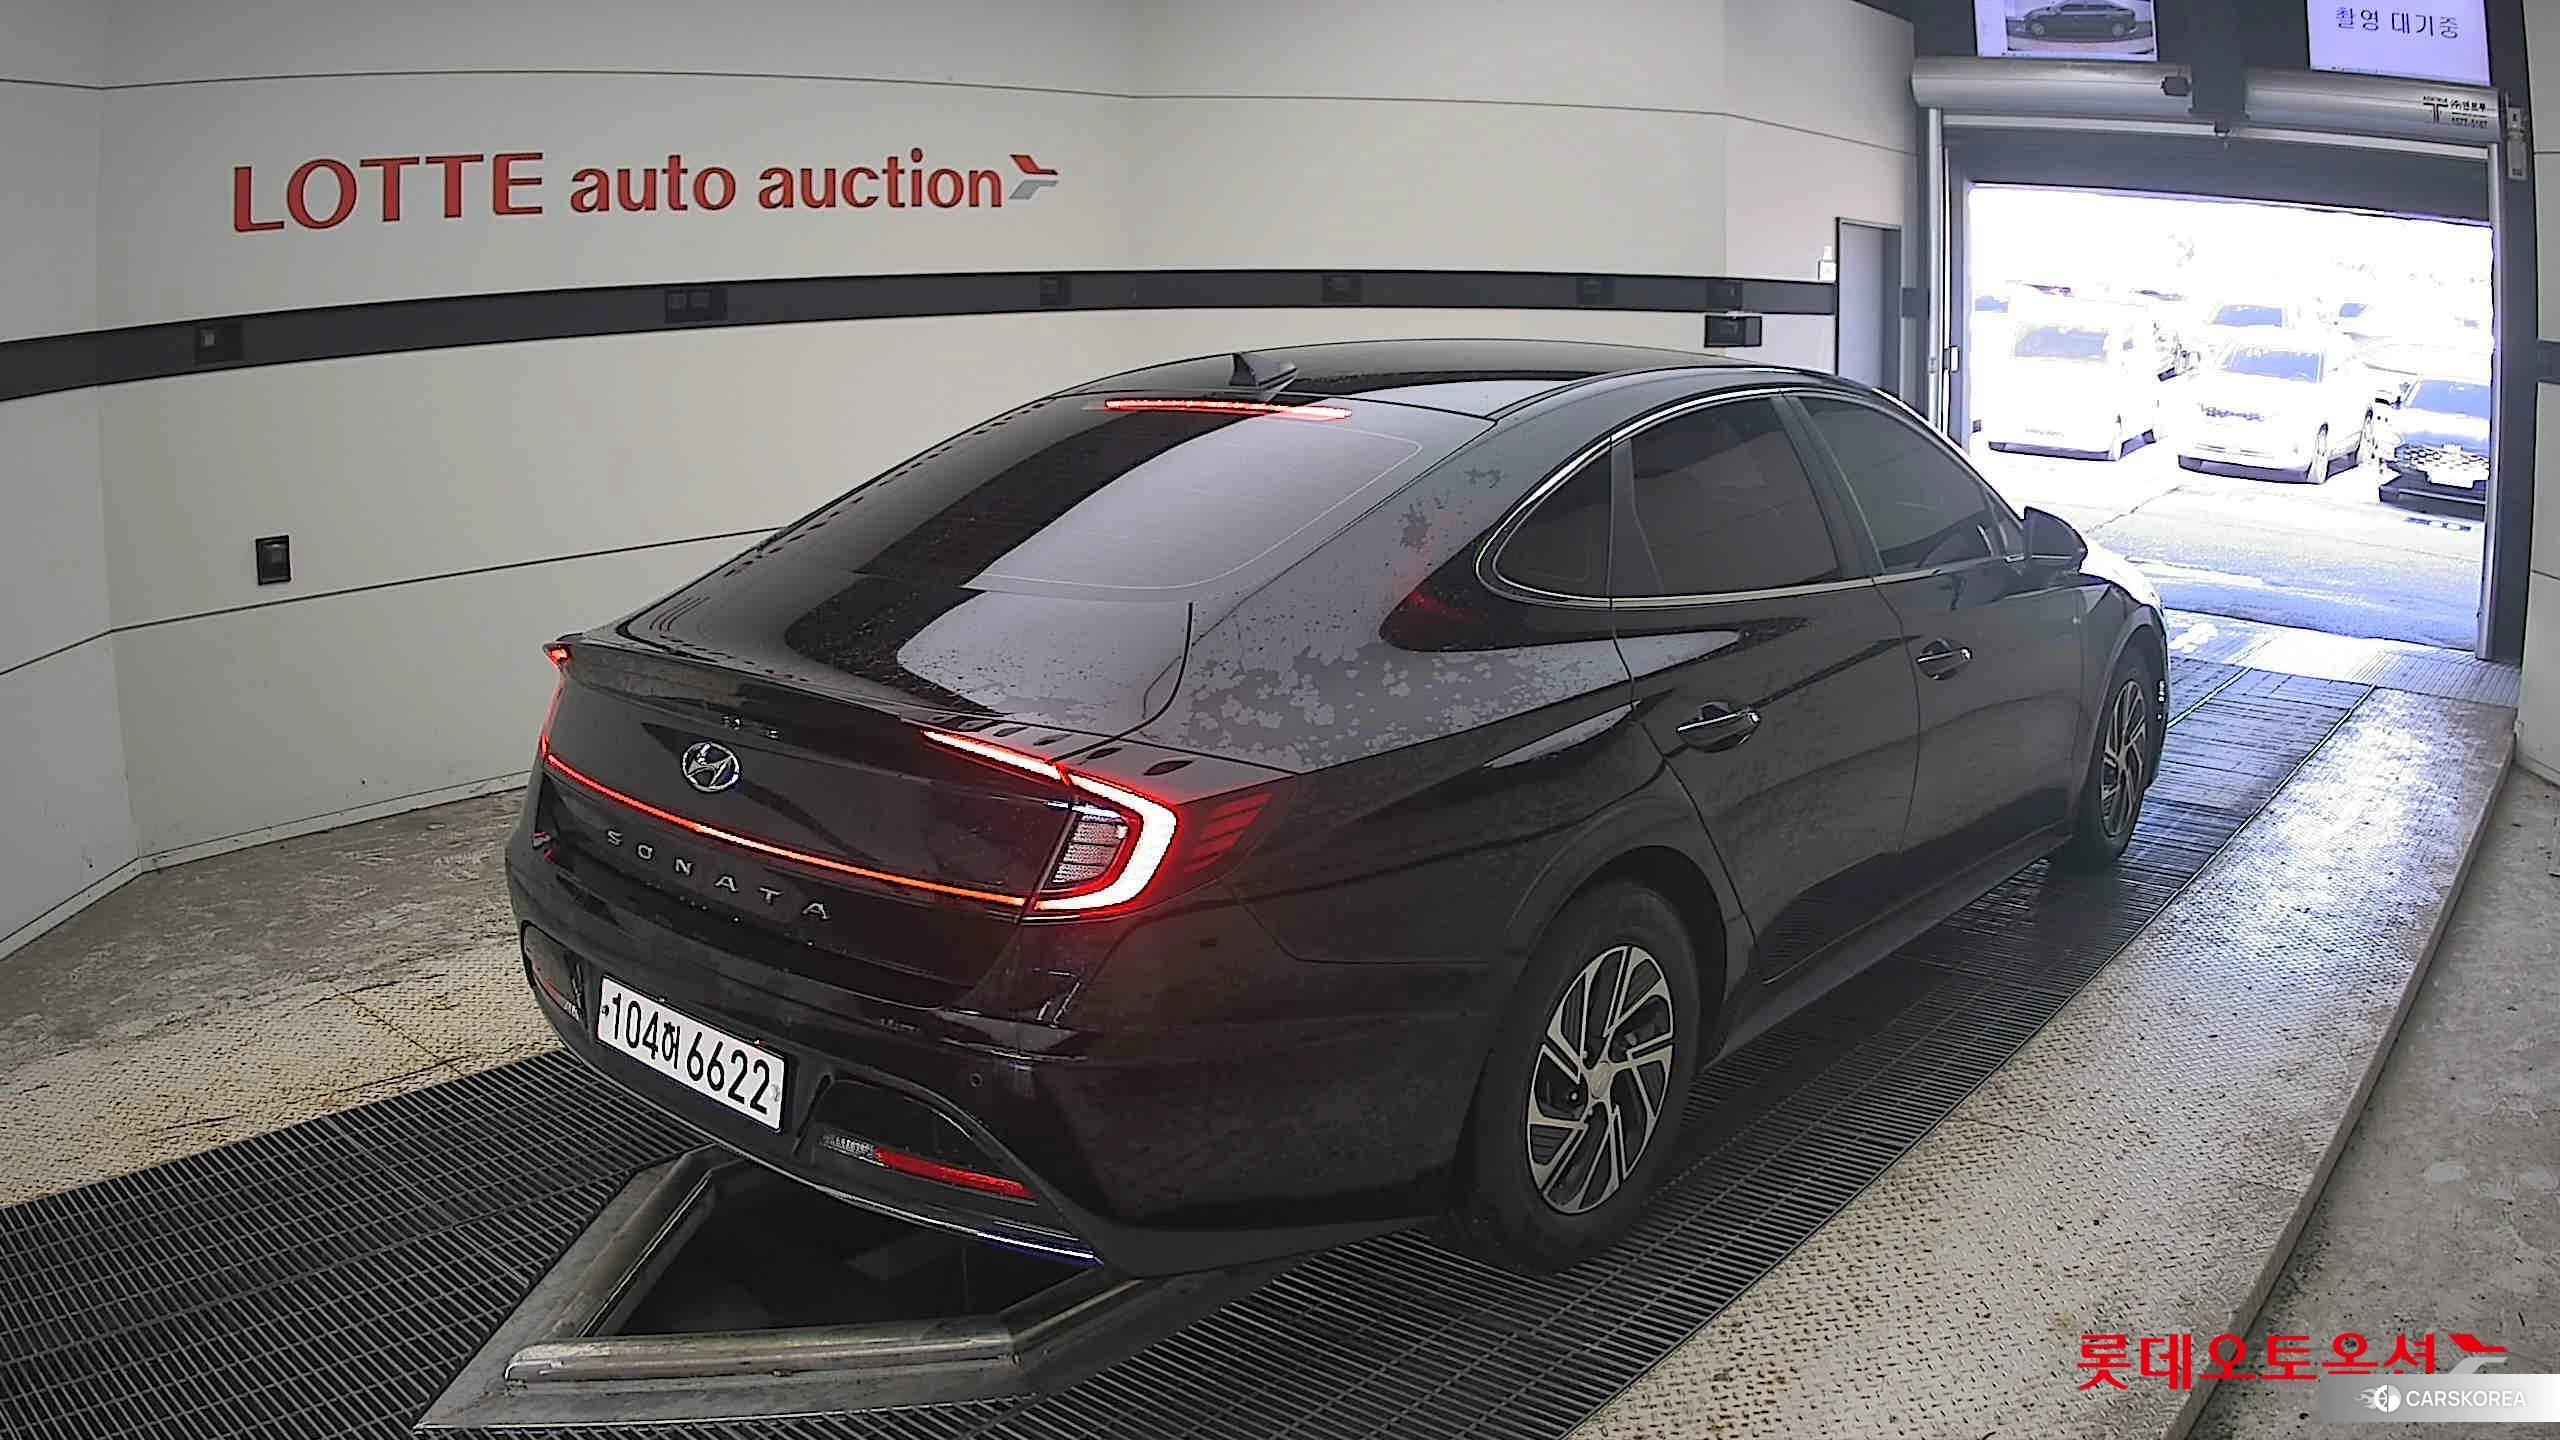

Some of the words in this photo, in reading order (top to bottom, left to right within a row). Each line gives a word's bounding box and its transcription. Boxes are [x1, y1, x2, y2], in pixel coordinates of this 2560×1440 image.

[2336, 7, 2379, 31] 촬영
[2391, 12, 2459, 39] 대기중
[234, 152, 543, 232] LOTTE
[570, 154, 736, 212] auto
[757, 147, 1003, 209] auction
[607, 829, 829, 920] SONATA
